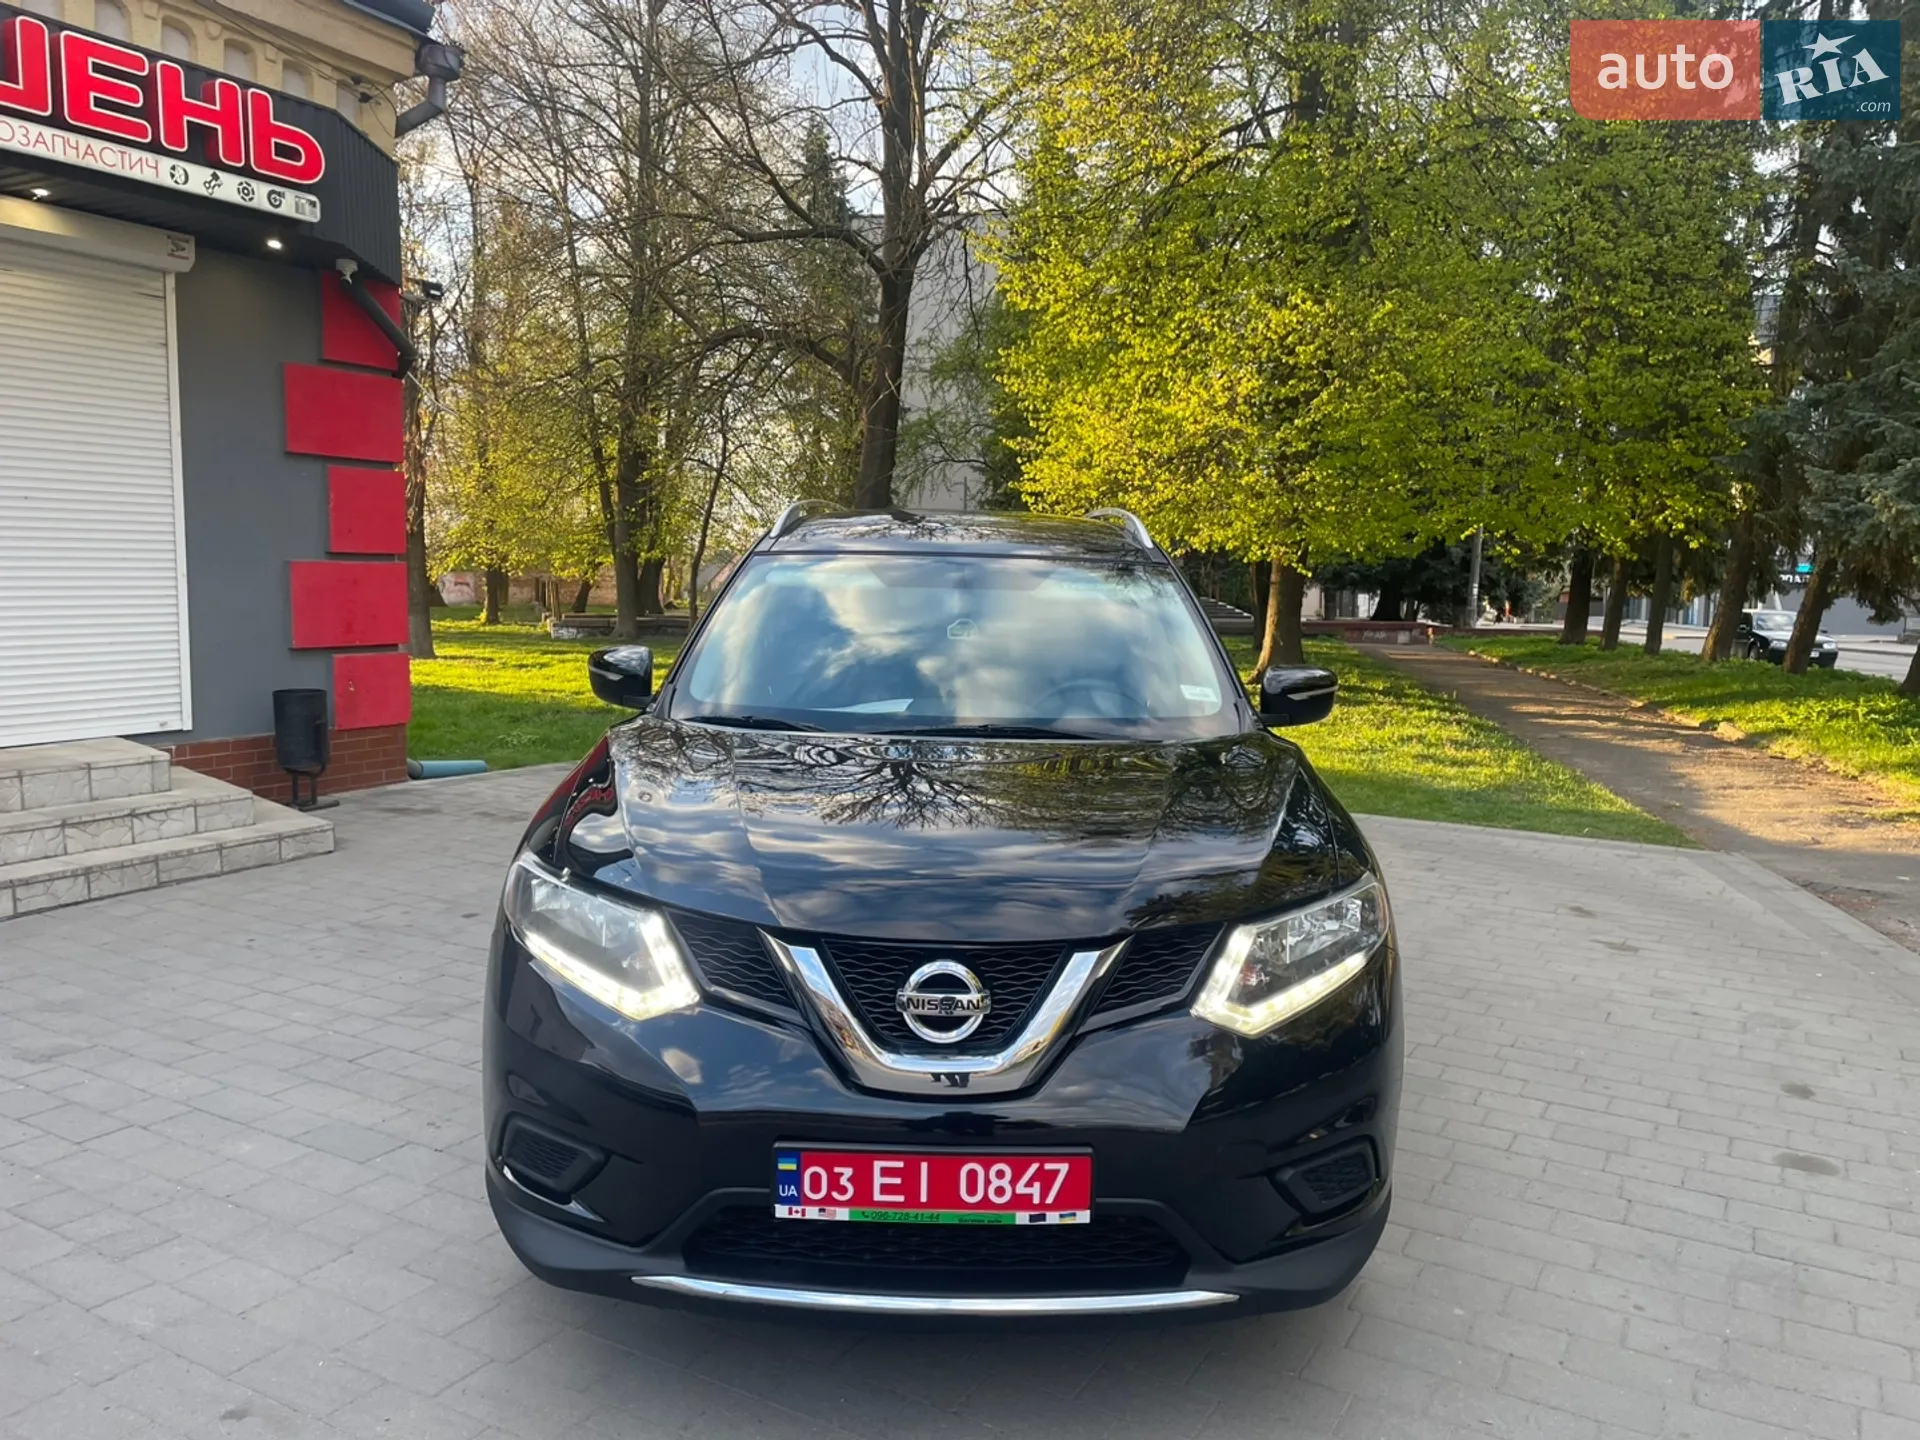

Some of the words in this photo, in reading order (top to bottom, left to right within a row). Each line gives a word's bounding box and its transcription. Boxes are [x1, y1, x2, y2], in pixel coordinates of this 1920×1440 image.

[906, 998, 981, 1011] NISSAN
[803, 1165, 854, 1201] 03
[873, 1160, 928, 1203] EI
[959, 1162, 1069, 1204] 0847
[778, 1184, 798, 1197] UA
